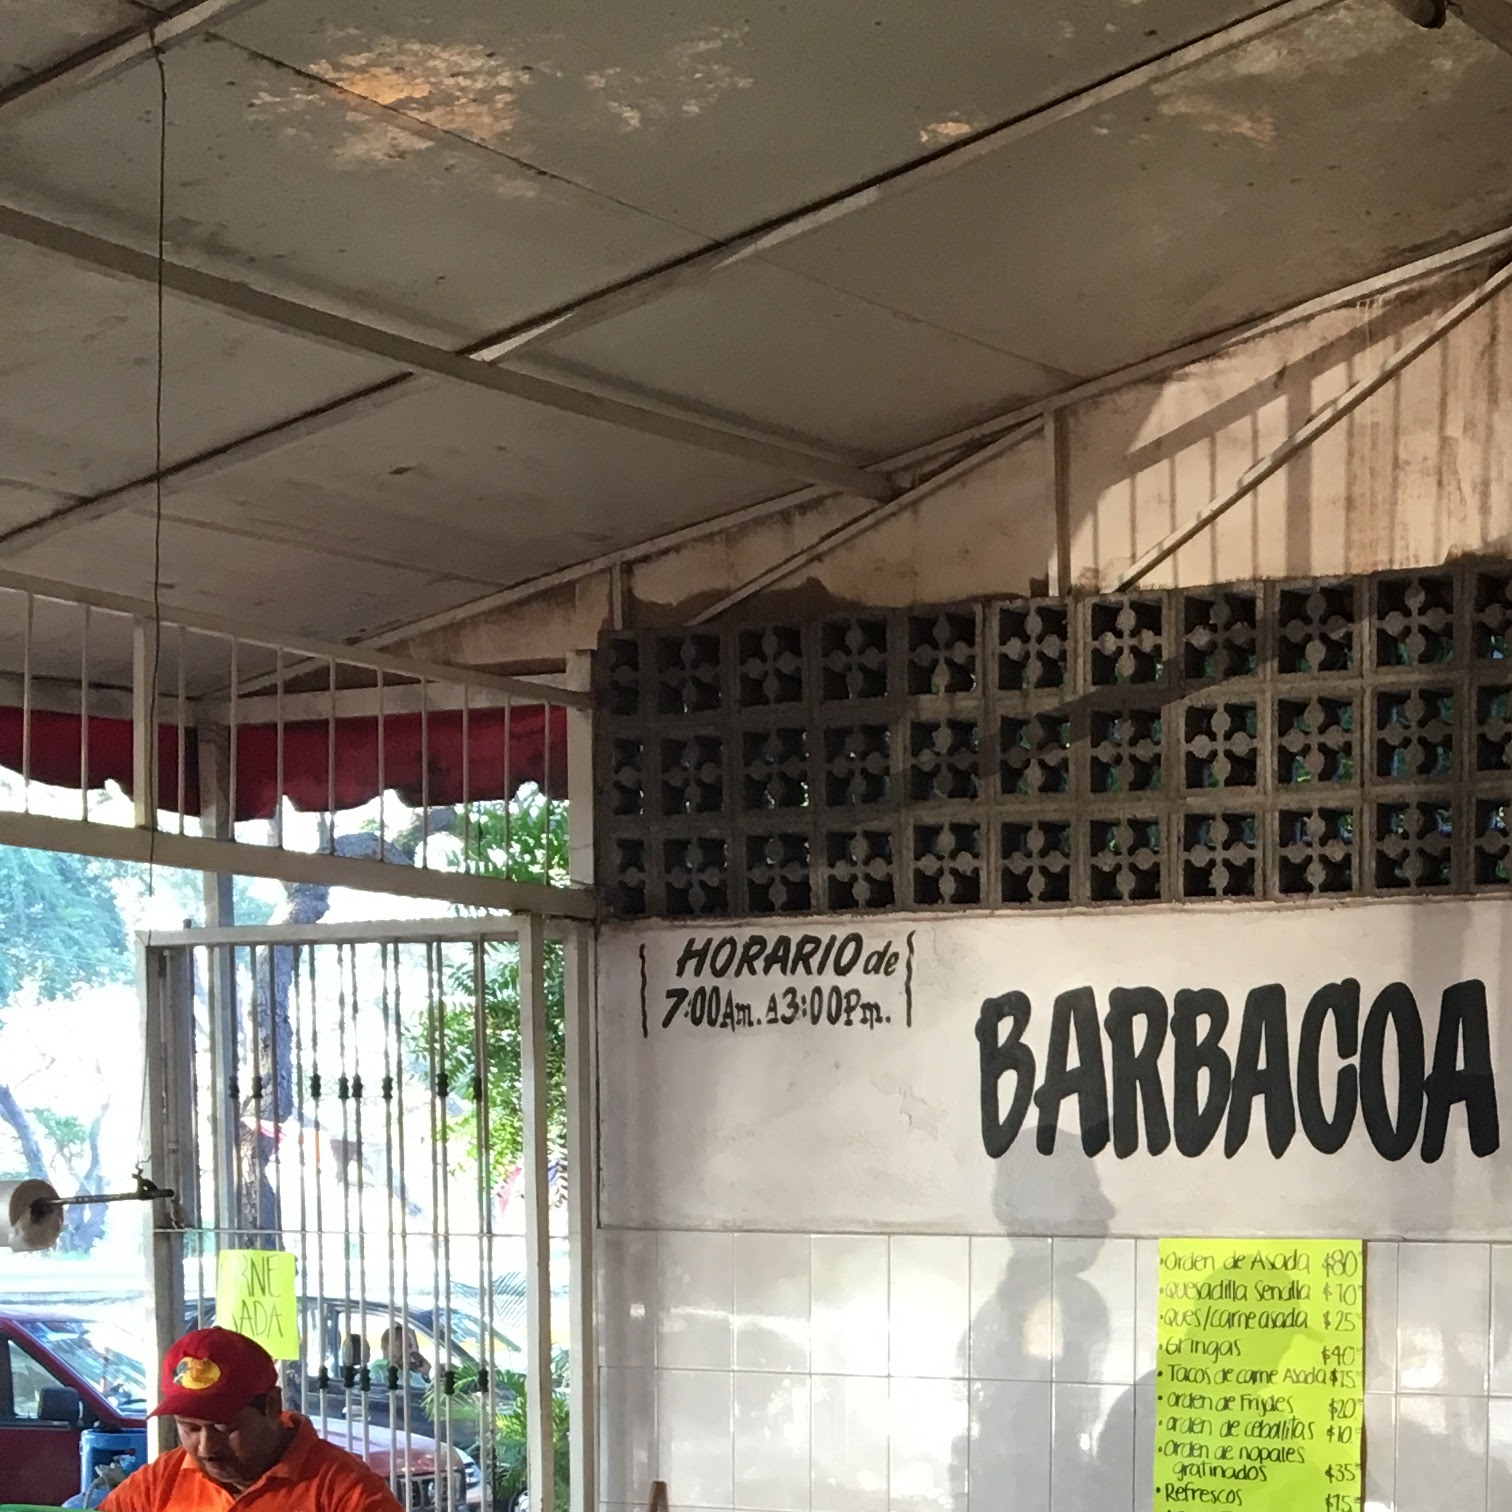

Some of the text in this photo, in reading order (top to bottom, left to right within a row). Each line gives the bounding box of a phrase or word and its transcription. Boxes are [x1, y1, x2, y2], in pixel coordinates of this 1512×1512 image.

[676, 932, 901, 979] HORARIO de
[975, 978, 1500, 1163] BARBACOA
[1164, 1251, 1216, 1272] Orden
[1223, 1250, 1245, 1270] de
[1250, 1249, 1310, 1274] Asada
[1254, 1279, 1311, 1302] Sencilla
[1258, 1307, 1308, 1329] asada
[1165, 1337, 1242, 1363] Gringas
[1167, 1364, 1212, 1386] Tacos
[1214, 1367, 1234, 1384] de
[1236, 1368, 1279, 1386] carne
[1282, 1366, 1327, 1385] Asada
[1215, 1394, 1236, 1411] de
[1219, 1419, 1240, 1437] de
[1214, 1444, 1234, 1461] de
[1239, 1447, 1306, 1464] nopales
[1172, 1460, 1268, 1482] gratinados
[1164, 1482, 1243, 1506] Refrescos
